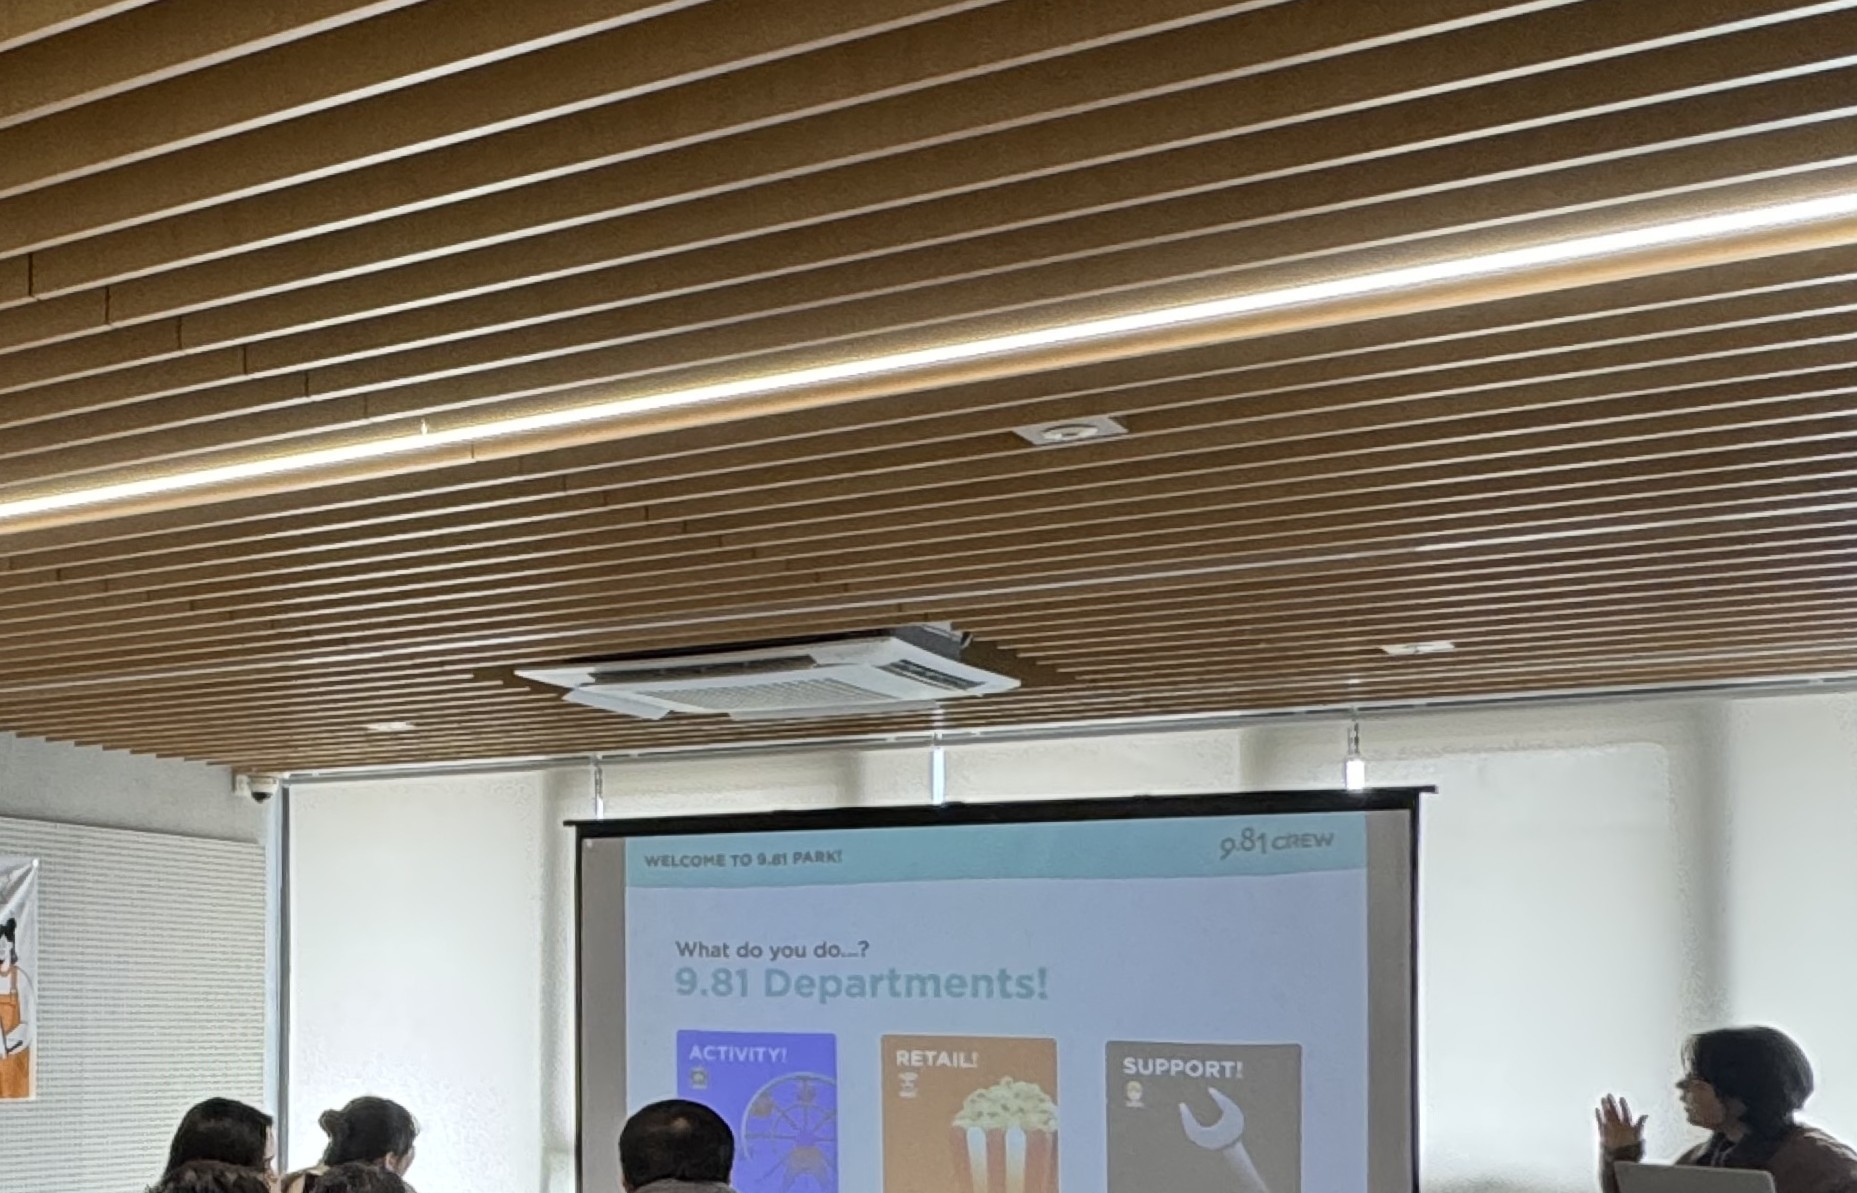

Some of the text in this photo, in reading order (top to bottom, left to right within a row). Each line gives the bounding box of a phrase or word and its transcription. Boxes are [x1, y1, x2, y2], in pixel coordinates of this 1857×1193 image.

[1272, 833, 1334, 850] CREW
[645, 850, 842, 867] WELCOME TO 9.81 PARK!
[675, 941, 729, 958] What
[737, 942, 763, 958] do
[769, 946, 806, 961] you
[675, 967, 1048, 1004] 9.81 Departments!
[689, 1044, 788, 1064] ACTIVITY!
[896, 1050, 978, 1068] RETAIL!
[1123, 1057, 1242, 1078] SUPPORT!
